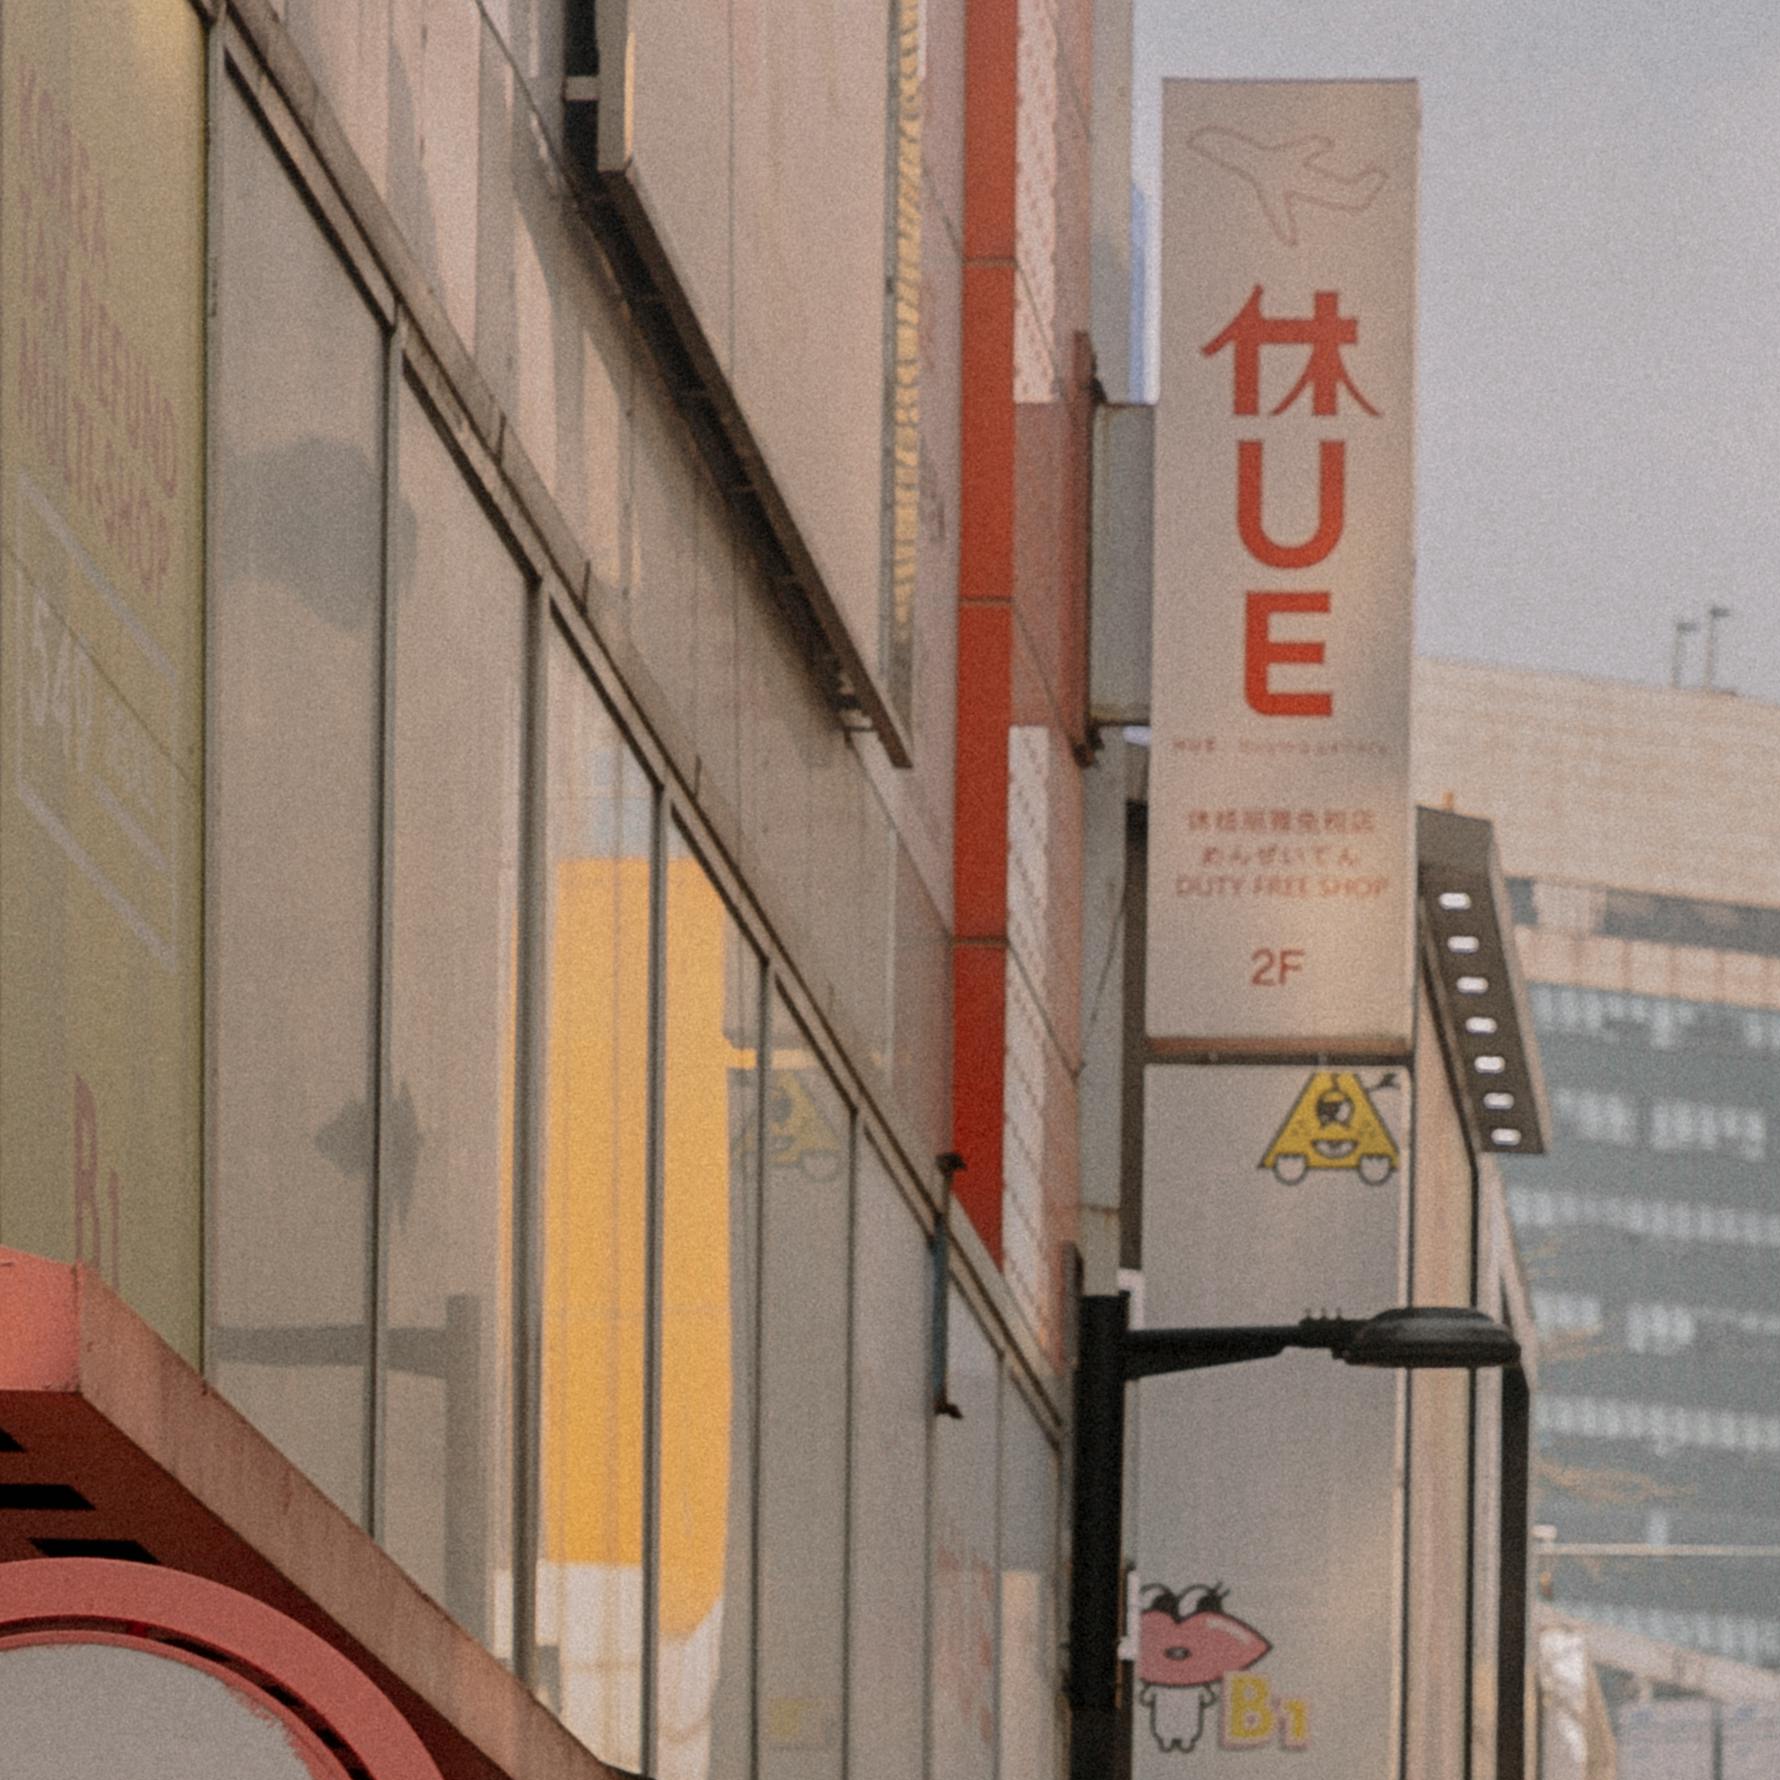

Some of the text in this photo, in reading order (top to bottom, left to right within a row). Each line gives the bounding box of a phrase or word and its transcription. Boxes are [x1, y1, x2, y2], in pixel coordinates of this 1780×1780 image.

[1176, 876, 1243, 897] DUTY
[1251, 876, 1307, 897] FREE
[1251, 947, 1305, 987] 2F
[1225, 1671, 1310, 1745] B1
